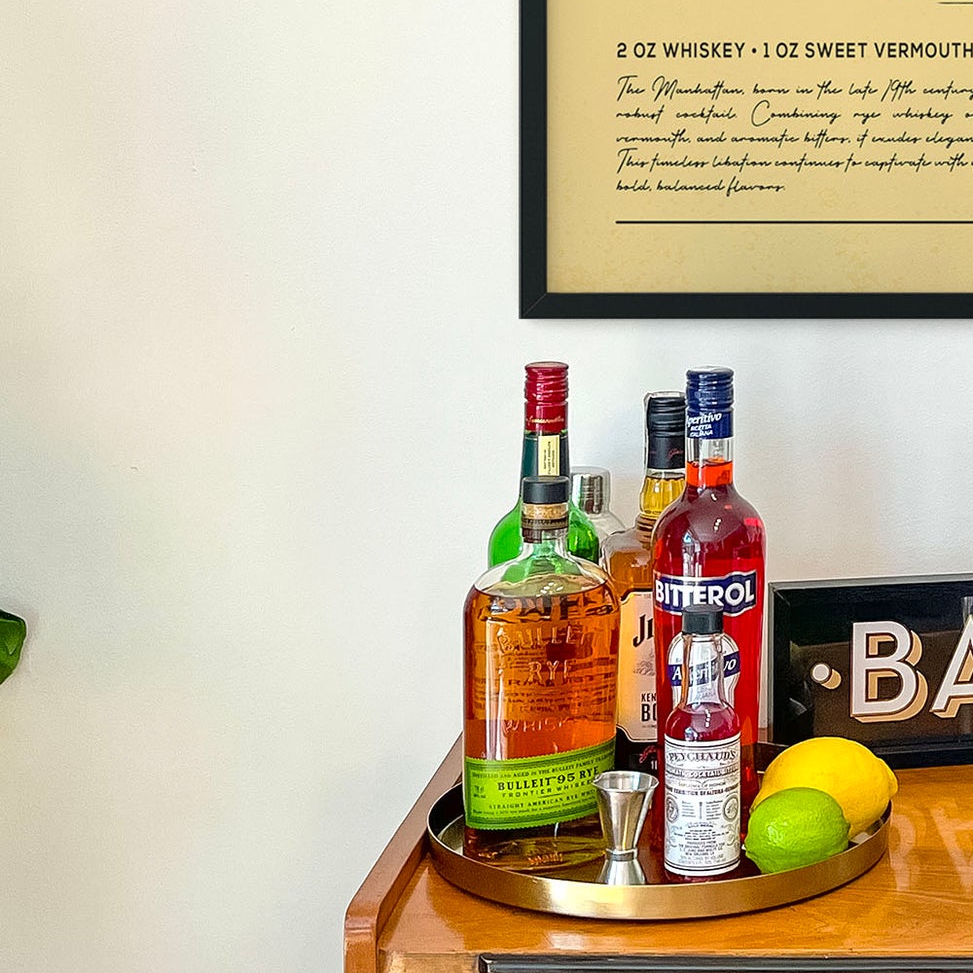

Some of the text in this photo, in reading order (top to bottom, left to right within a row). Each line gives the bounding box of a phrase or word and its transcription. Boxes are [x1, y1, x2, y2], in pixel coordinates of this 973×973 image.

[616, 42, 627, 58] 2
[633, 42, 657, 59] OZ
[663, 42, 746, 59] WHISKEY
[763, 42, 770, 58] 1
[776, 42, 799, 59] OZ
[805, 42, 868, 59] SWEET
[874, 42, 973, 59] VERMOUTH
[616, 75, 646, 102] The
[651, 75, 745, 102] Manhattan,
[752, 83, 790, 95] born
[795, 85, 814, 95] in
[817, 79, 843, 100] the
[848, 80, 879, 100] late
[881, 78, 917, 102] 19th
[616, 104, 665, 125] robust
[750, 99, 842, 127] Combining
[853, 111, 884, 125] rye
[892, 107, 954, 125] whiskey
[696, 131, 728, 143] and
[730, 128, 800, 149] aromatic
[856, 128, 869, 149] it
[871, 131, 922, 144] exudes
[616, 147, 650, 174] This
[649, 152, 710, 173] timeless
[711, 152, 773, 173] libation
[774, 152, 845, 173] continues
[843, 152, 863, 173] to
[864, 152, 932, 173] captivate
[934, 152, 969, 173] with
[615, 179, 652, 192] bold,
[656, 179, 727, 192] balanced
[655, 579, 755, 607] BITTEROL
[498, 766, 599, 791] BULLEIT 95 RYE
[557, 779, 594, 791] WHISKE
